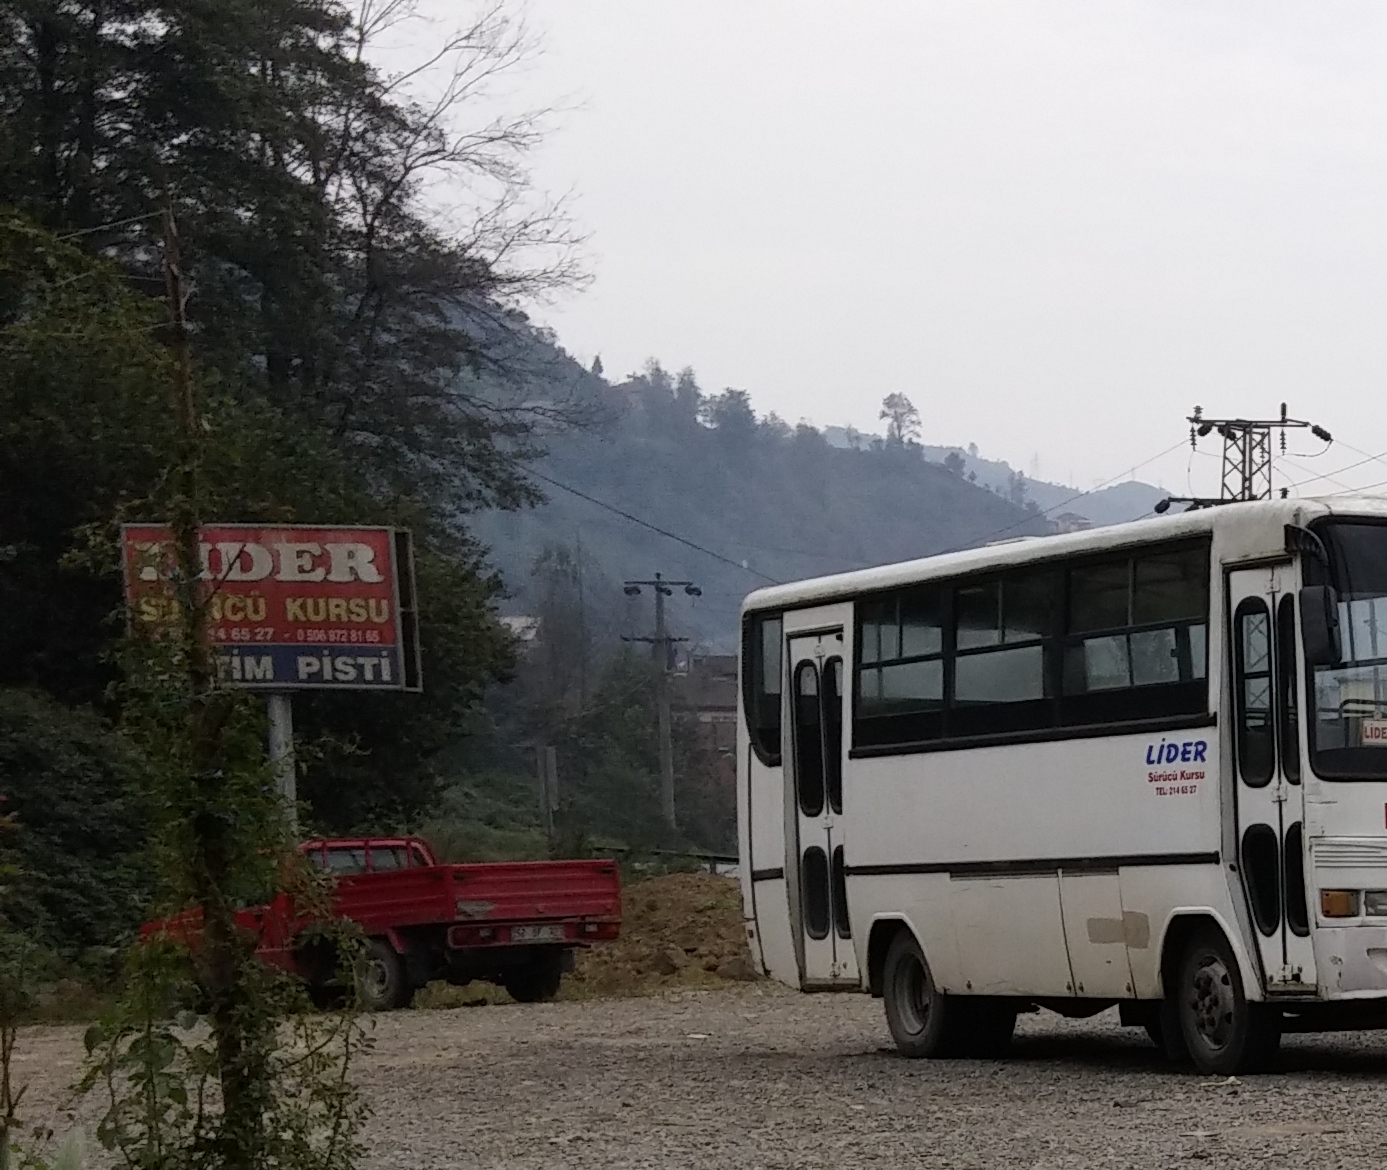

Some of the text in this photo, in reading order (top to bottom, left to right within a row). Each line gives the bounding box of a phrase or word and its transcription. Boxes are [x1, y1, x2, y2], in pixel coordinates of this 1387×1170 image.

[136, 541, 385, 583] İDER
[286, 598, 390, 624] KURSU
[254, 627, 274, 642] 27
[296, 649, 392, 682] PİSTİ
[1145, 737, 1208, 765] LİDER
[1179, 769, 1205, 781] Kursu
